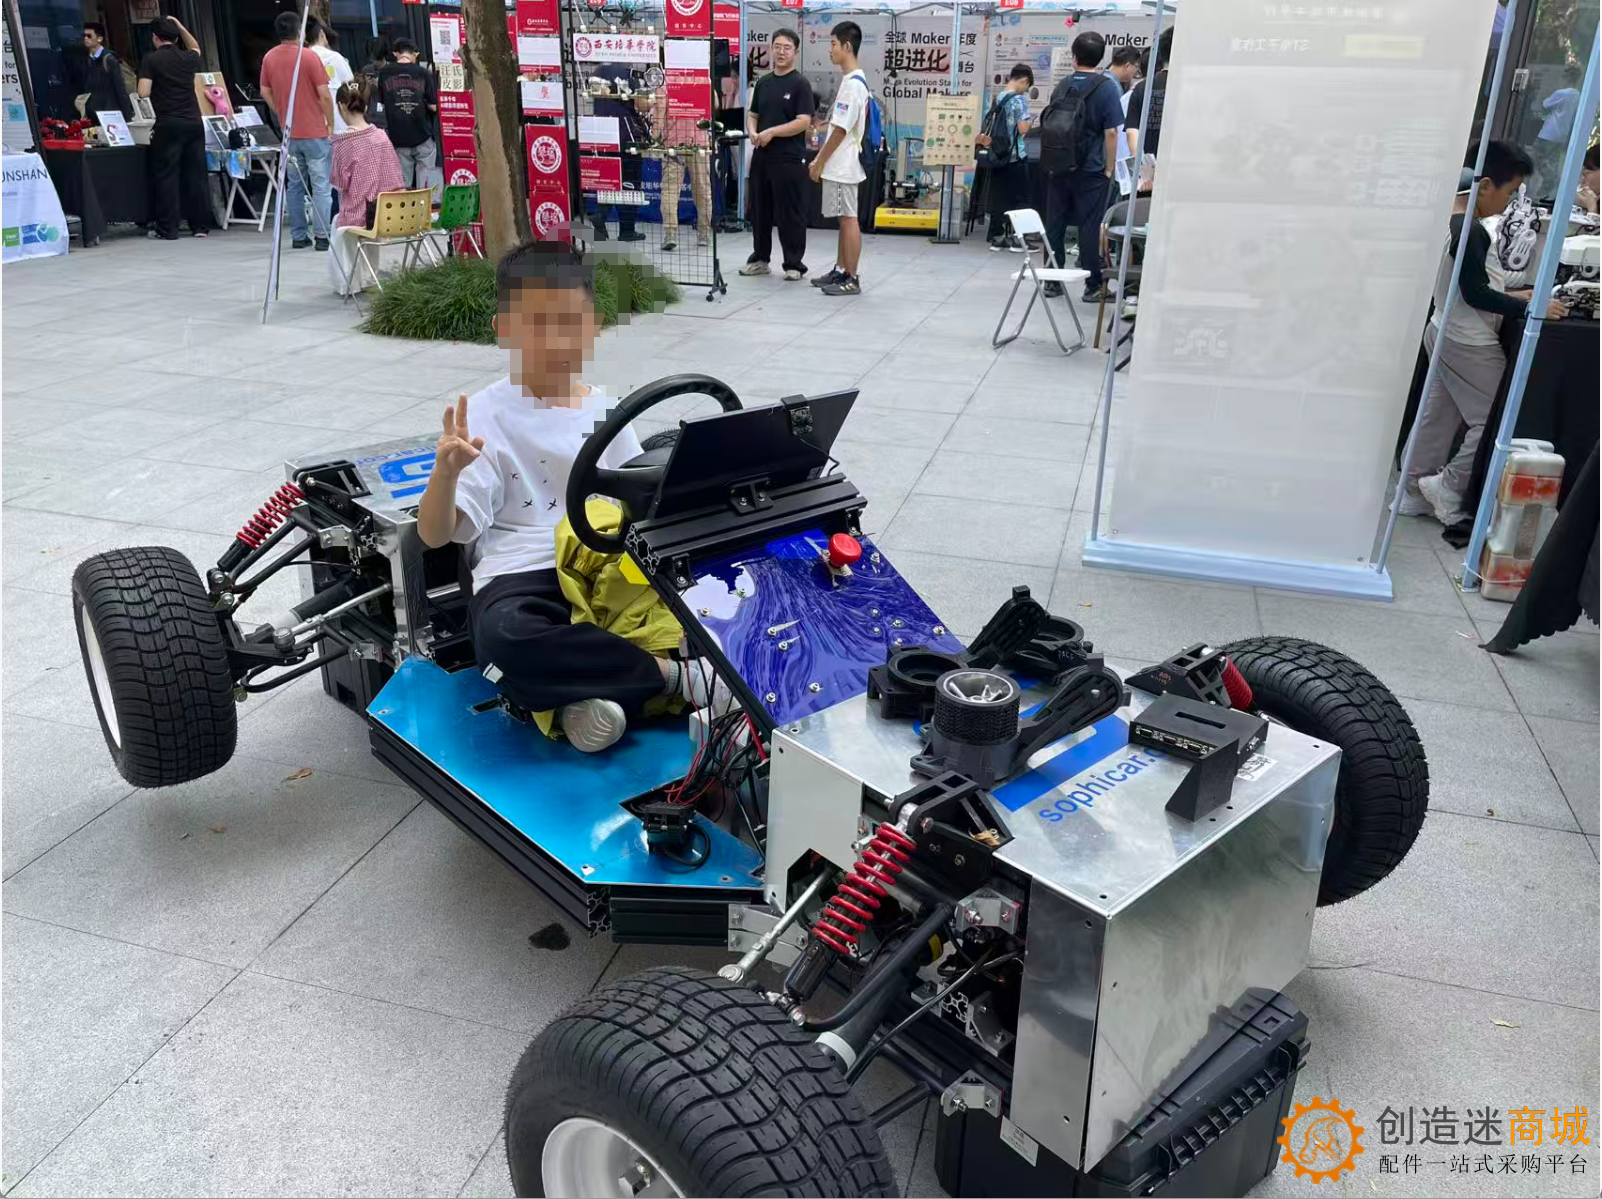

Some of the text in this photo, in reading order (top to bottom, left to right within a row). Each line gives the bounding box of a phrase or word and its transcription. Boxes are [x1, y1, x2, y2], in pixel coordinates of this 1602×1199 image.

[885, 31, 906, 43] 全球
[911, 32, 951, 44] Maker
[1105, 33, 1148, 46] Maker
[884, 48, 950, 72] 超进化
[883, 78, 902, 87] Mga
[904, 78, 937, 87] Evolution
[962, 79, 972, 87] for
[883, 86, 971, 98] Global Makrs
